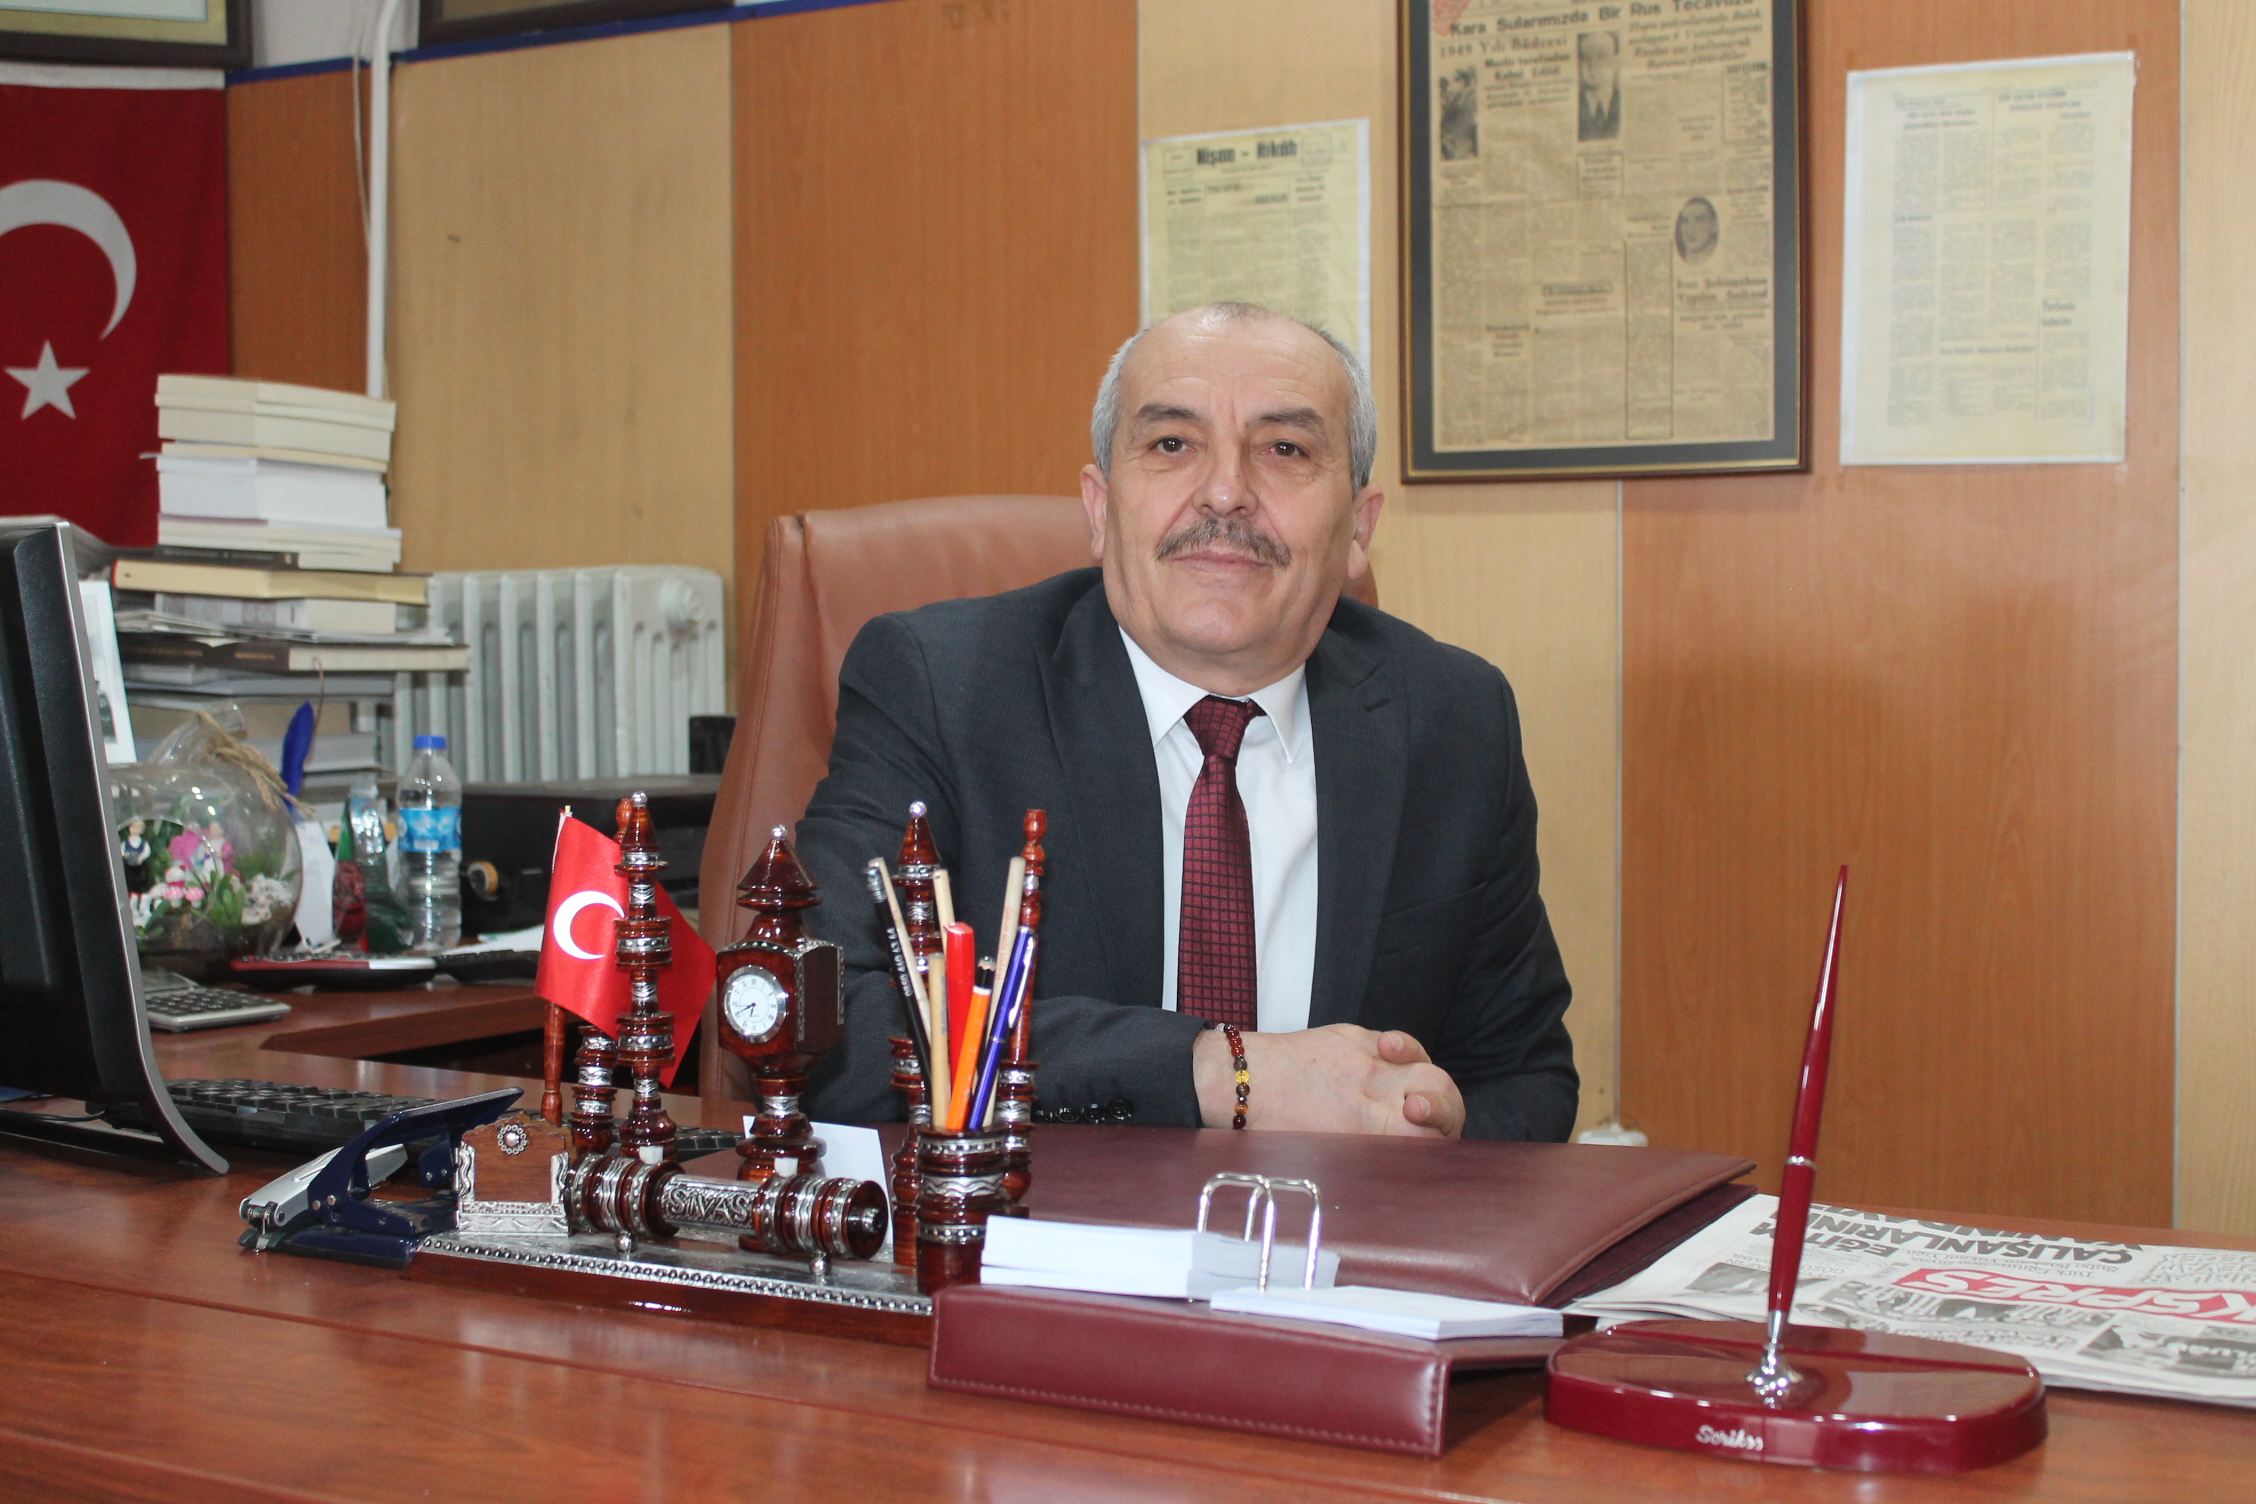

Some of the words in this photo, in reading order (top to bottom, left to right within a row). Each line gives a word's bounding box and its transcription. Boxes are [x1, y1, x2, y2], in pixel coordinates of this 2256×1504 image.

[1450, 23, 1486, 36] Kara
[1599, 6, 1621, 21] Bir
[1630, 2, 1661, 17] Rus
[1749, 1221, 1901, 1258] EĞİTM
